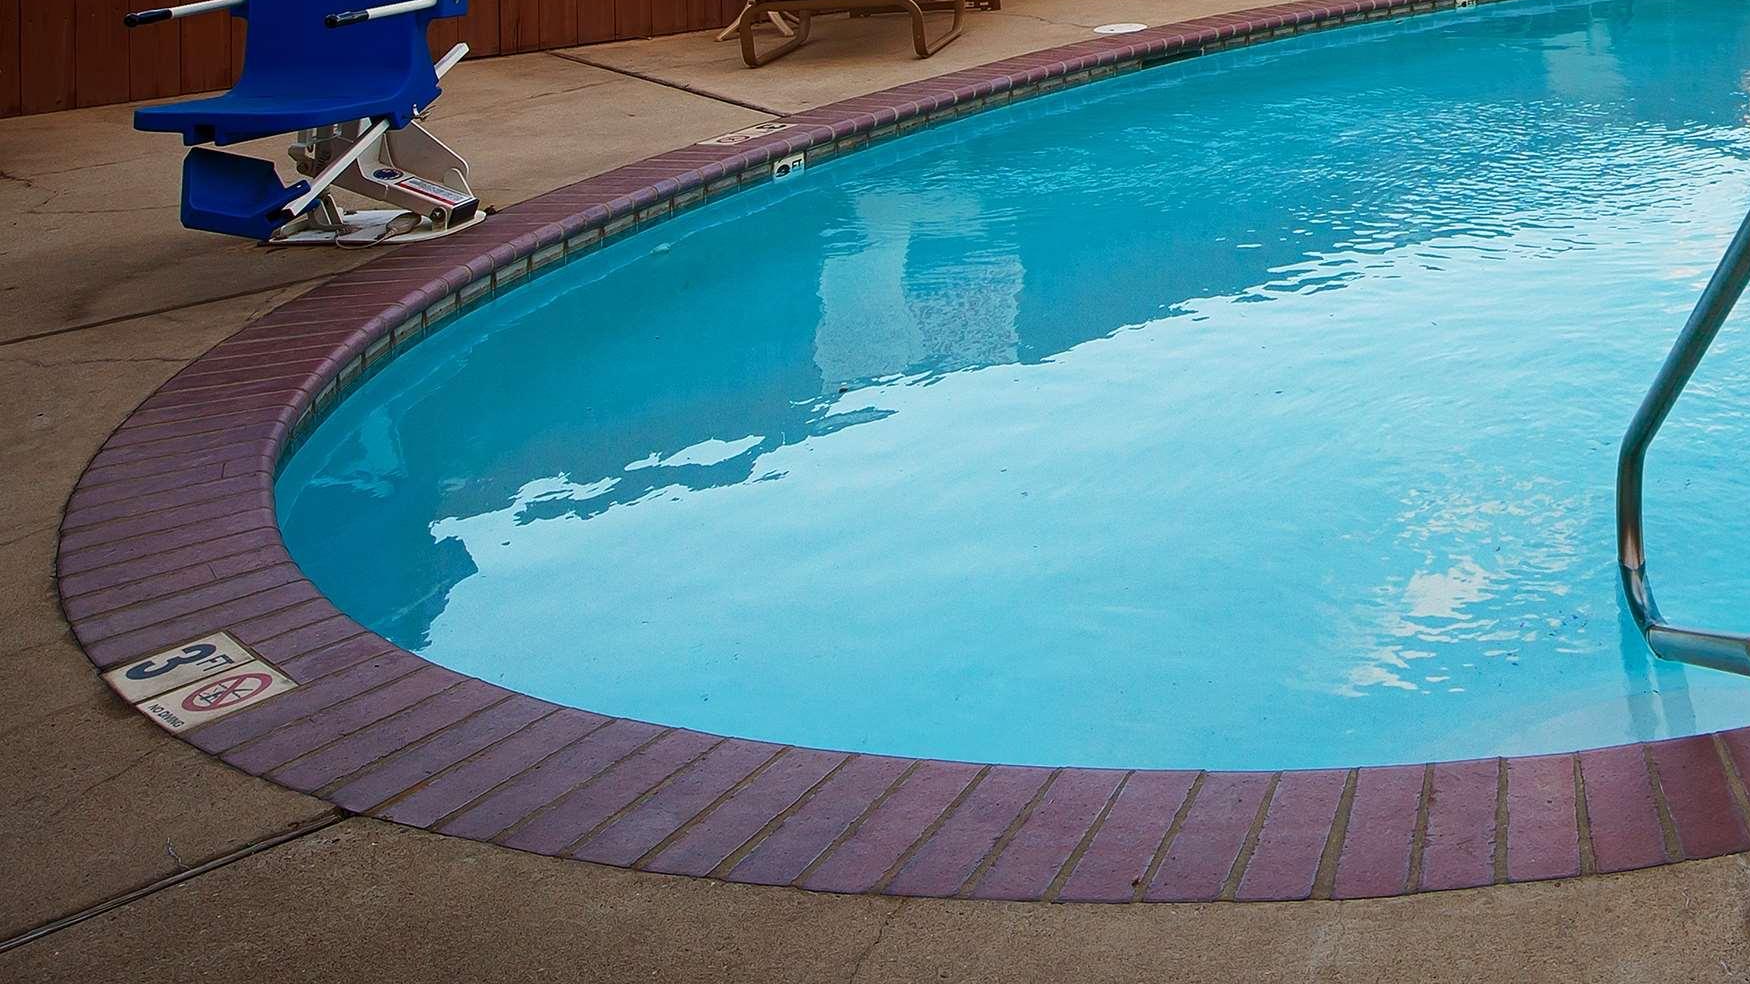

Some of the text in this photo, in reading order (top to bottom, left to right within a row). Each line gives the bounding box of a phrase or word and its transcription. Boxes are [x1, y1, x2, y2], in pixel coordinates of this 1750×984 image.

[125, 643, 235, 680] 3 FT
[148, 703, 164, 713] NO
